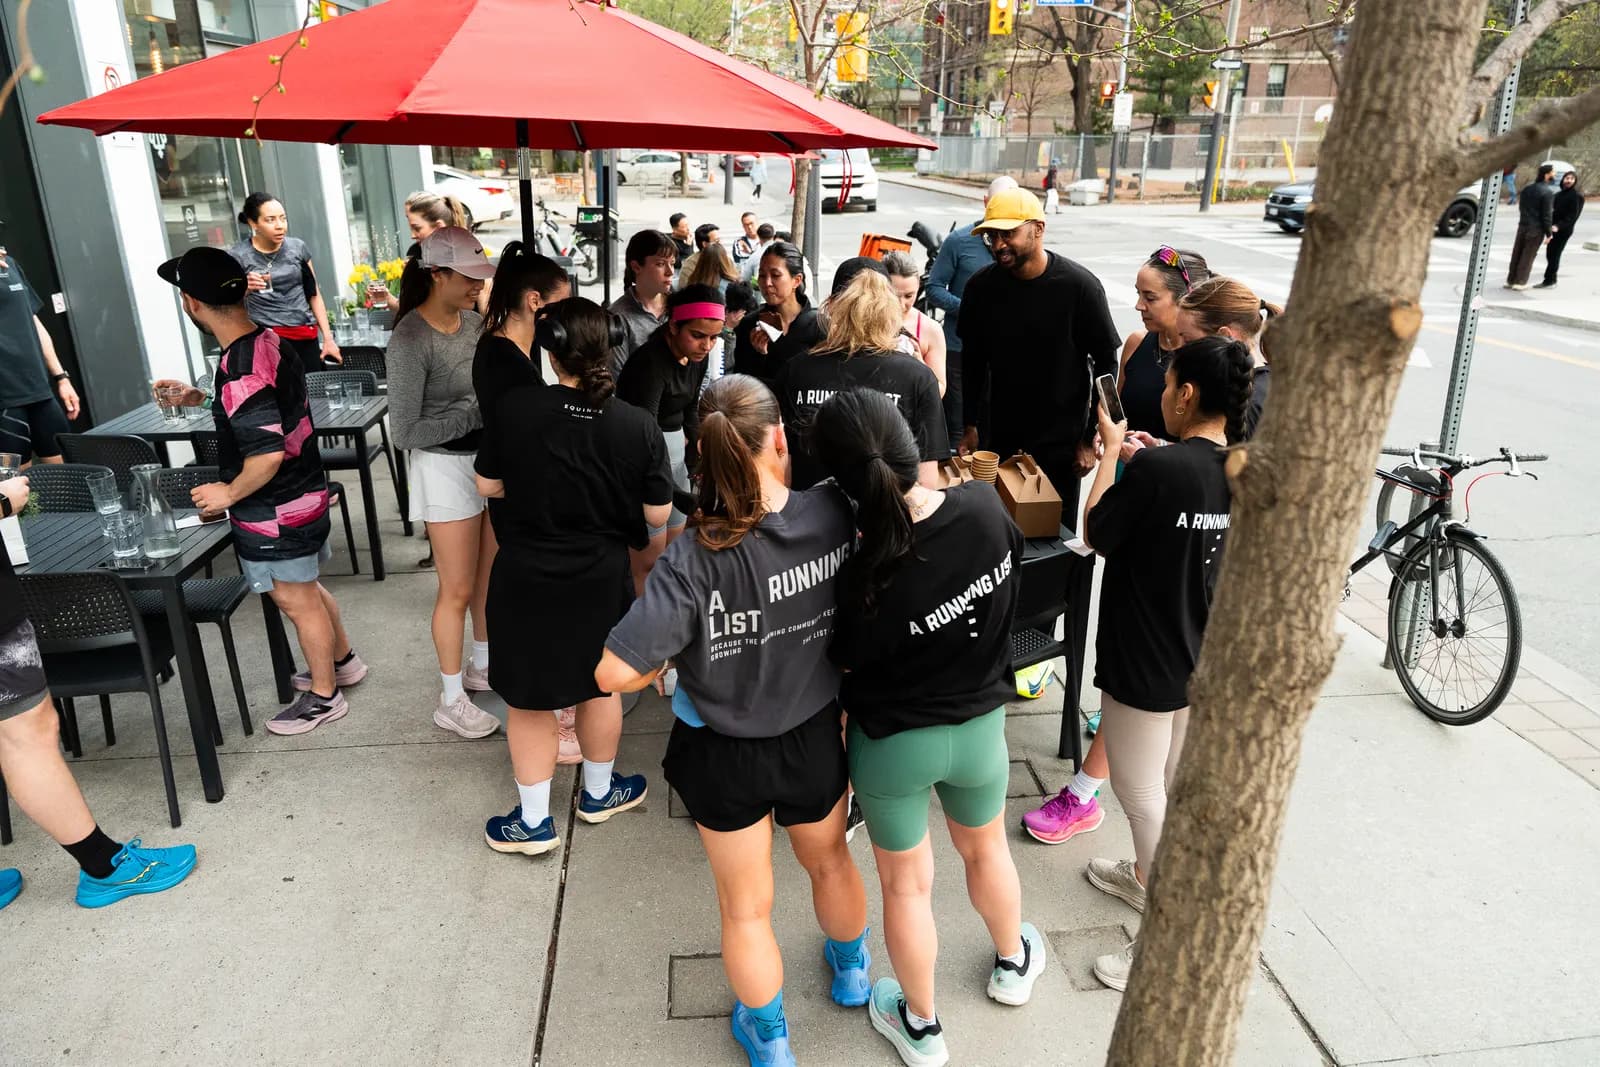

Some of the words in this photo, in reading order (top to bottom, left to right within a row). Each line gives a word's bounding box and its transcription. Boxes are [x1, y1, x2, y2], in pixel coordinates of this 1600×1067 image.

[796, 390, 804, 404] A
[1175, 512, 1188, 529] A
[1192, 513, 1232, 530] RUNNIN
[908, 621, 925, 636] A
[993, 549, 1013, 586] LIST
[708, 590, 726, 615] A
[708, 609, 762, 641] LIST
[709, 637, 743, 653] BECAUSE
[744, 637, 759, 646] THE
[710, 647, 742, 662] GROWING
